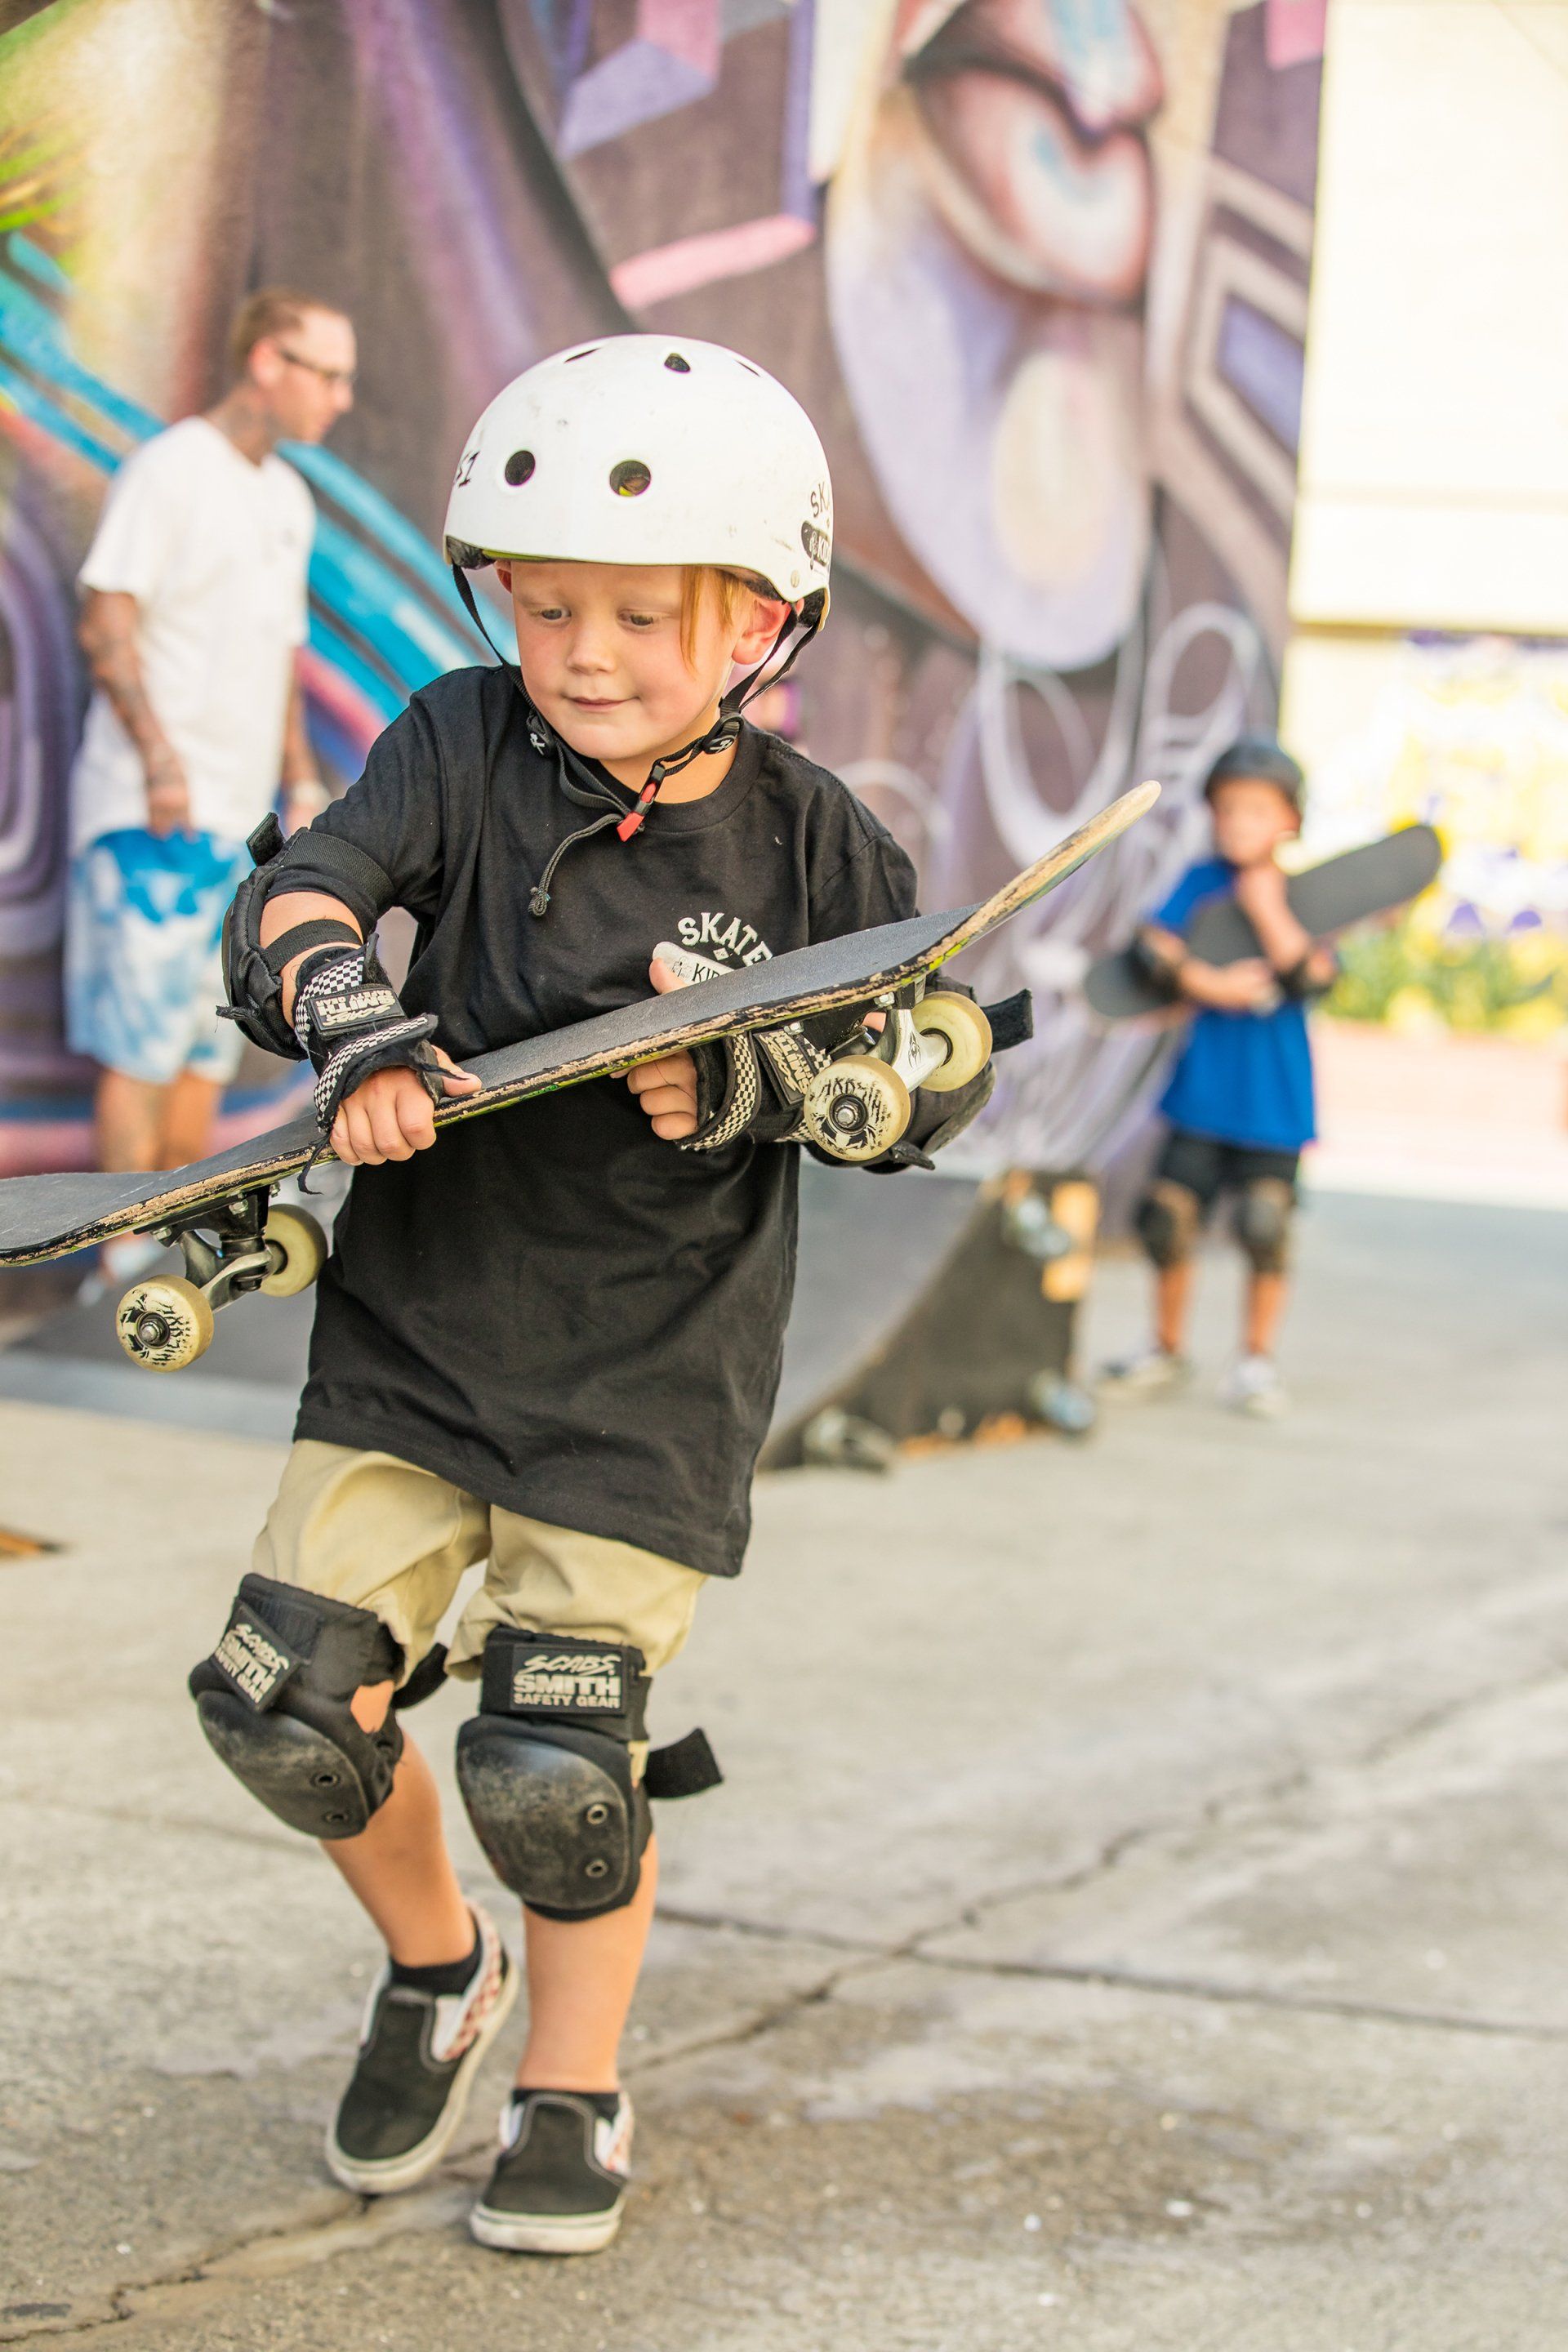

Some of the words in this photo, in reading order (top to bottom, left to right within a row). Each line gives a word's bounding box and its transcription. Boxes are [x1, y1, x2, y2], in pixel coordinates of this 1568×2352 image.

[677, 911, 774, 967] SKATE
[317, 995, 396, 1017] SMITH
[513, 1673, 621, 1696] SMITH
[513, 1692, 572, 1707] SAFETY
[575, 1695, 621, 1708] GEAR
